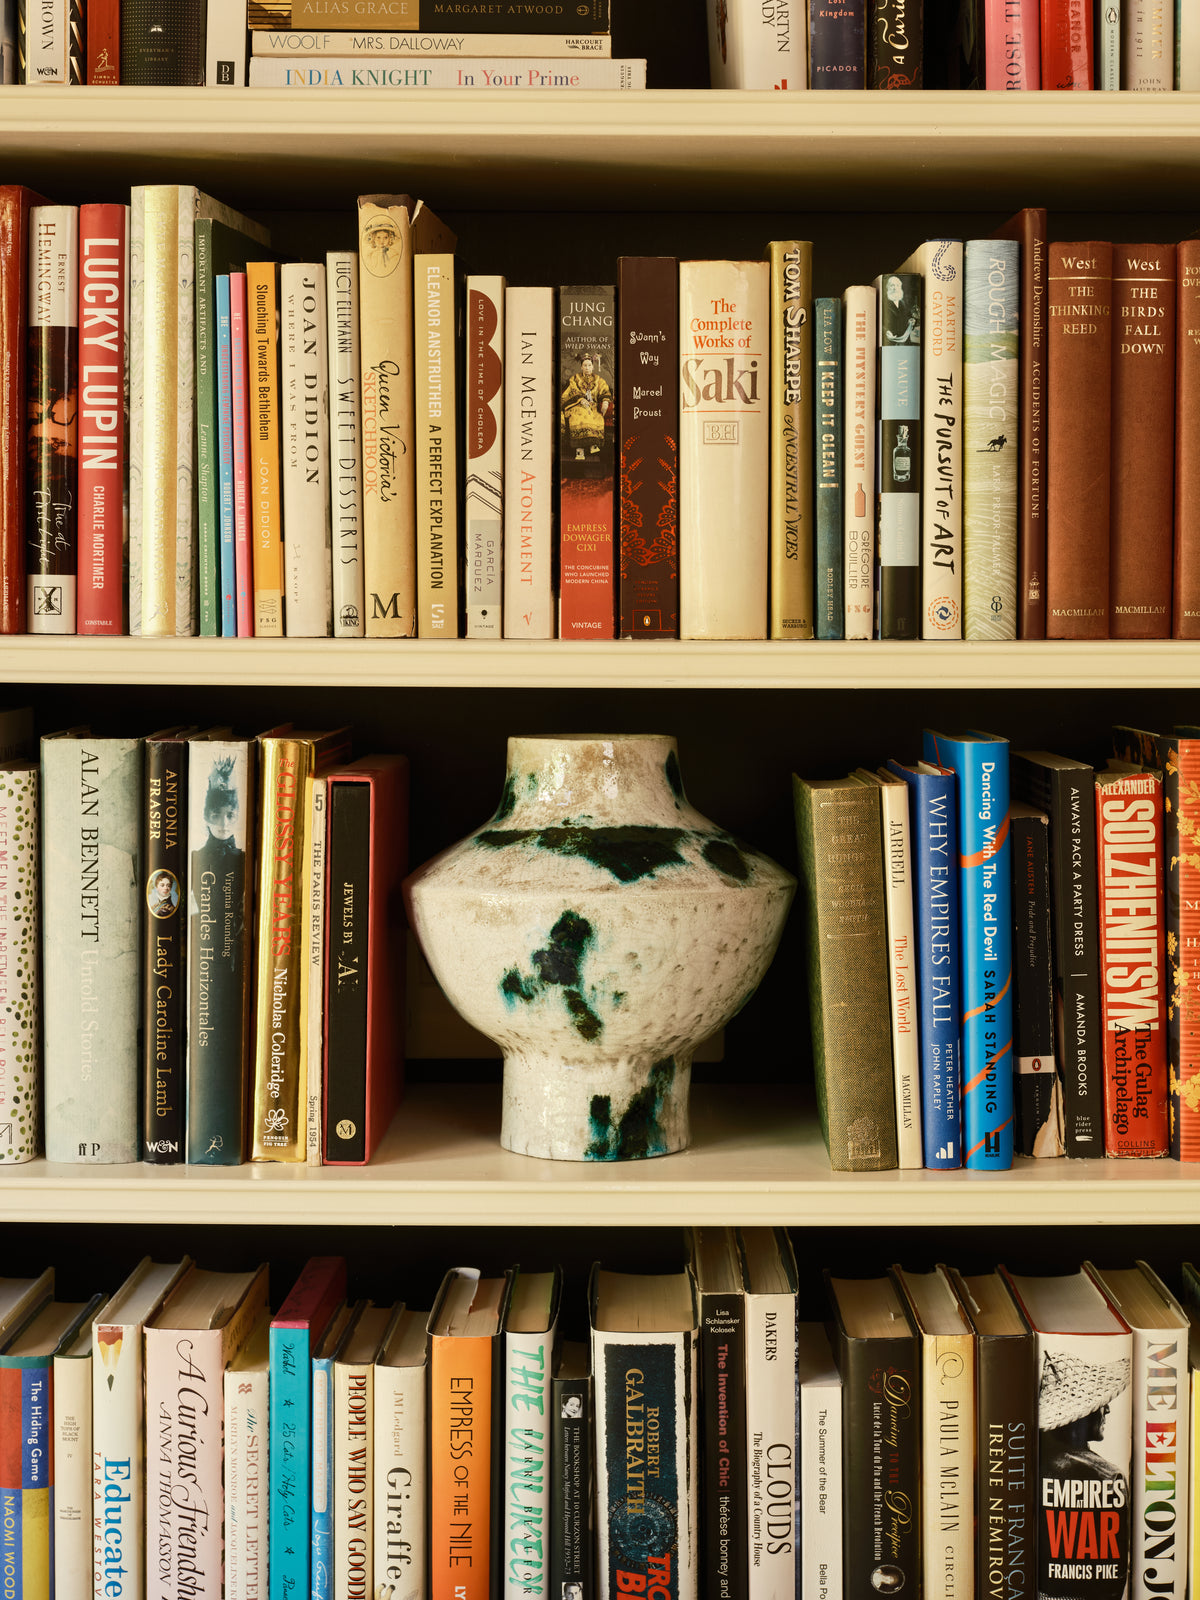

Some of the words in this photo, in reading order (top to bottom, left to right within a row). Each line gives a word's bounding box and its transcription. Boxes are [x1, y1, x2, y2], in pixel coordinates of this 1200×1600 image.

[303, 2, 349, 13] ALIAS
[355, 2, 409, 14] GRACE
[434, 4, 502, 14] MARGARET
[507, 5, 563, 14] ATWOOD
[285, 69, 344, 86] INDIA
[352, 69, 432, 86] KNIGHT
[457, 69, 475, 86] In
[481, 69, 522, 86] Your
[528, 69, 580, 86] Prime
[817, 65, 857, 73] PICADOR
[57, 253, 68, 293] ERNEST
[199, 234, 207, 293] IMPORTANT
[1060, 257, 1097, 270] West
[1127, 258, 1161, 271] West
[83, 238, 120, 353] LUCKY
[255, 285, 269, 335] Slouching
[427, 266, 441, 327] ELEANOR
[569, 302, 606, 315] JUNG
[711, 298, 736, 315] The
[1049, 305, 1110, 317] THINKING
[1068, 286, 1094, 297] THE
[1121, 306, 1165, 318] BIRDS
[1130, 288, 1158, 299] THE
[199, 297, 208, 351] ARTIFACTS
[302, 277, 318, 357] JOAN
[478, 326, 484, 336] IN
[562, 315, 613, 327] CHANG
[690, 317, 752, 332] Complete
[823, 309, 832, 327] LIA
[932, 291, 943, 357] GAYFORD
[946, 296, 957, 352] MARTIN
[1062, 323, 1097, 335] REED
[1125, 325, 1161, 336] FALL
[200, 354, 208, 375] AND
[257, 338, 270, 383] Towards
[692, 335, 734, 349] Works
[738, 335, 752, 349] of
[823, 331, 833, 354] LOW
[1120, 343, 1165, 354] DOWN
[427, 331, 442, 418] ANSTRUTHER
[478, 389, 484, 401] OF
[682, 357, 760, 410] Saki
[1032, 360, 1041, 432] ACCIDENTS
[82, 365, 119, 470] LUPIN
[258, 387, 271, 441] Bethlehem
[303, 373, 319, 485] DIDION
[363, 371, 379, 496] SKETCHBOOK
[429, 424, 442, 433] A
[429, 438, 442, 495] PERFECT
[1031, 438, 1040, 453] OF
[259, 457, 270, 495] JOAN
[1031, 460, 1040, 519] FORTUNE
[92, 485, 106, 531] CHARLIE
[260, 501, 271, 549] DIDION
[567, 524, 607, 532] EMPRESS
[430, 499, 444, 589] EXPLANATION
[563, 533, 612, 542] DOWAGER
[576, 543, 597, 552] CIXI
[848, 530, 858, 589] BOUILLIER
[92, 533, 105, 590] MORTIMER
[1052, 608, 1104, 617] MACMILLAN
[1115, 606, 1166, 614] MACMILLAN
[81, 749, 100, 817] ALAN
[979, 762, 996, 820] Dancing
[149, 778, 161, 840] FRASER
[165, 769, 178, 850] ANTONIA
[928, 794, 949, 857] WHY
[1070, 787, 1082, 834] ALWAYS
[889, 820, 906, 889] JARRELL
[982, 825, 997, 859] With
[1071, 838, 1082, 868] PACK
[81, 827, 100, 943] BENNETT
[983, 863, 997, 889] The
[1072, 872, 1082, 880] A
[200, 870, 217, 940] Grandes
[343, 882, 354, 928] JEWELS
[929, 865, 951, 965] EMPIRES
[983, 894, 998, 922] Red
[1073, 884, 1084, 918] PARTY
[1102, 799, 1160, 1031] SOLZHENITSYN
[153, 936, 173, 978] Lady
[343, 931, 353, 945] BY
[983, 926, 999, 961] Devil
[1074, 922, 1085, 956] DRESS
[198, 947, 215, 1047] Horizontales
[271, 968, 289, 1029] Nicholas
[932, 975, 953, 1028] FALL
[983, 970, 997, 1023] SARAH
[1075, 993, 1086, 1044] AMANDA
[155, 985, 173, 1061] Caroline
[1134, 1022, 1152, 1060] The
[266, 1032, 287, 1099] Coleridge
[931, 1043, 941, 1071] JOHN
[945, 1043, 954, 1073] PETER
[984, 1032, 998, 1114] STANDING
[1076, 1049, 1088, 1096] BROOKS
[1111, 1022, 1133, 1135] Archipelago
[155, 1067, 173, 1118] Lamb
[932, 1074, 942, 1111] RAPLEY
[946, 1076, 955, 1121] HEATHER
[1132, 1063, 1153, 1119] Gulag
[1117, 1140, 1156, 1148] COLLINS
[717, 1344, 729, 1370] The
[765, 1312, 778, 1361] DAKERS
[31, 1381, 42, 1402] The
[1146, 1340, 1178, 1411] ME
[27, 1406, 43, 1445] Hiding
[348, 1374, 367, 1441] PEOPLE
[450, 1377, 474, 1460] EMPRESS
[718, 1373, 730, 1436] Invention
[31, 1448, 42, 1481] Game
[625, 1368, 645, 1516] GALBRAITH
[647, 1406, 660, 1479] ROBERT
[719, 1440, 730, 1454] of
[1007, 1422, 1026, 1491] SUITE
[348, 1447, 367, 1494] WHO
[453, 1465, 469, 1488] OF
[719, 1457, 731, 1487] Chic
[1144, 1420, 1177, 1562] ELTON
[348, 1499, 367, 1532] SAY
[453, 1494, 469, 1516] THE
[573, 1488, 580, 1499] AT
[573, 1501, 580, 1510] 10
[766, 1443, 793, 1555] CLOUDS
[1042, 1478, 1126, 1509] EMPIRES
[386, 1467, 413, 1580] Giraffe
[449, 1523, 473, 1569] NILE
[1045, 1509, 1120, 1560] WAR
[1048, 1563, 1093, 1580] FRANCIS
[1095, 1564, 1119, 1580] PIKE
